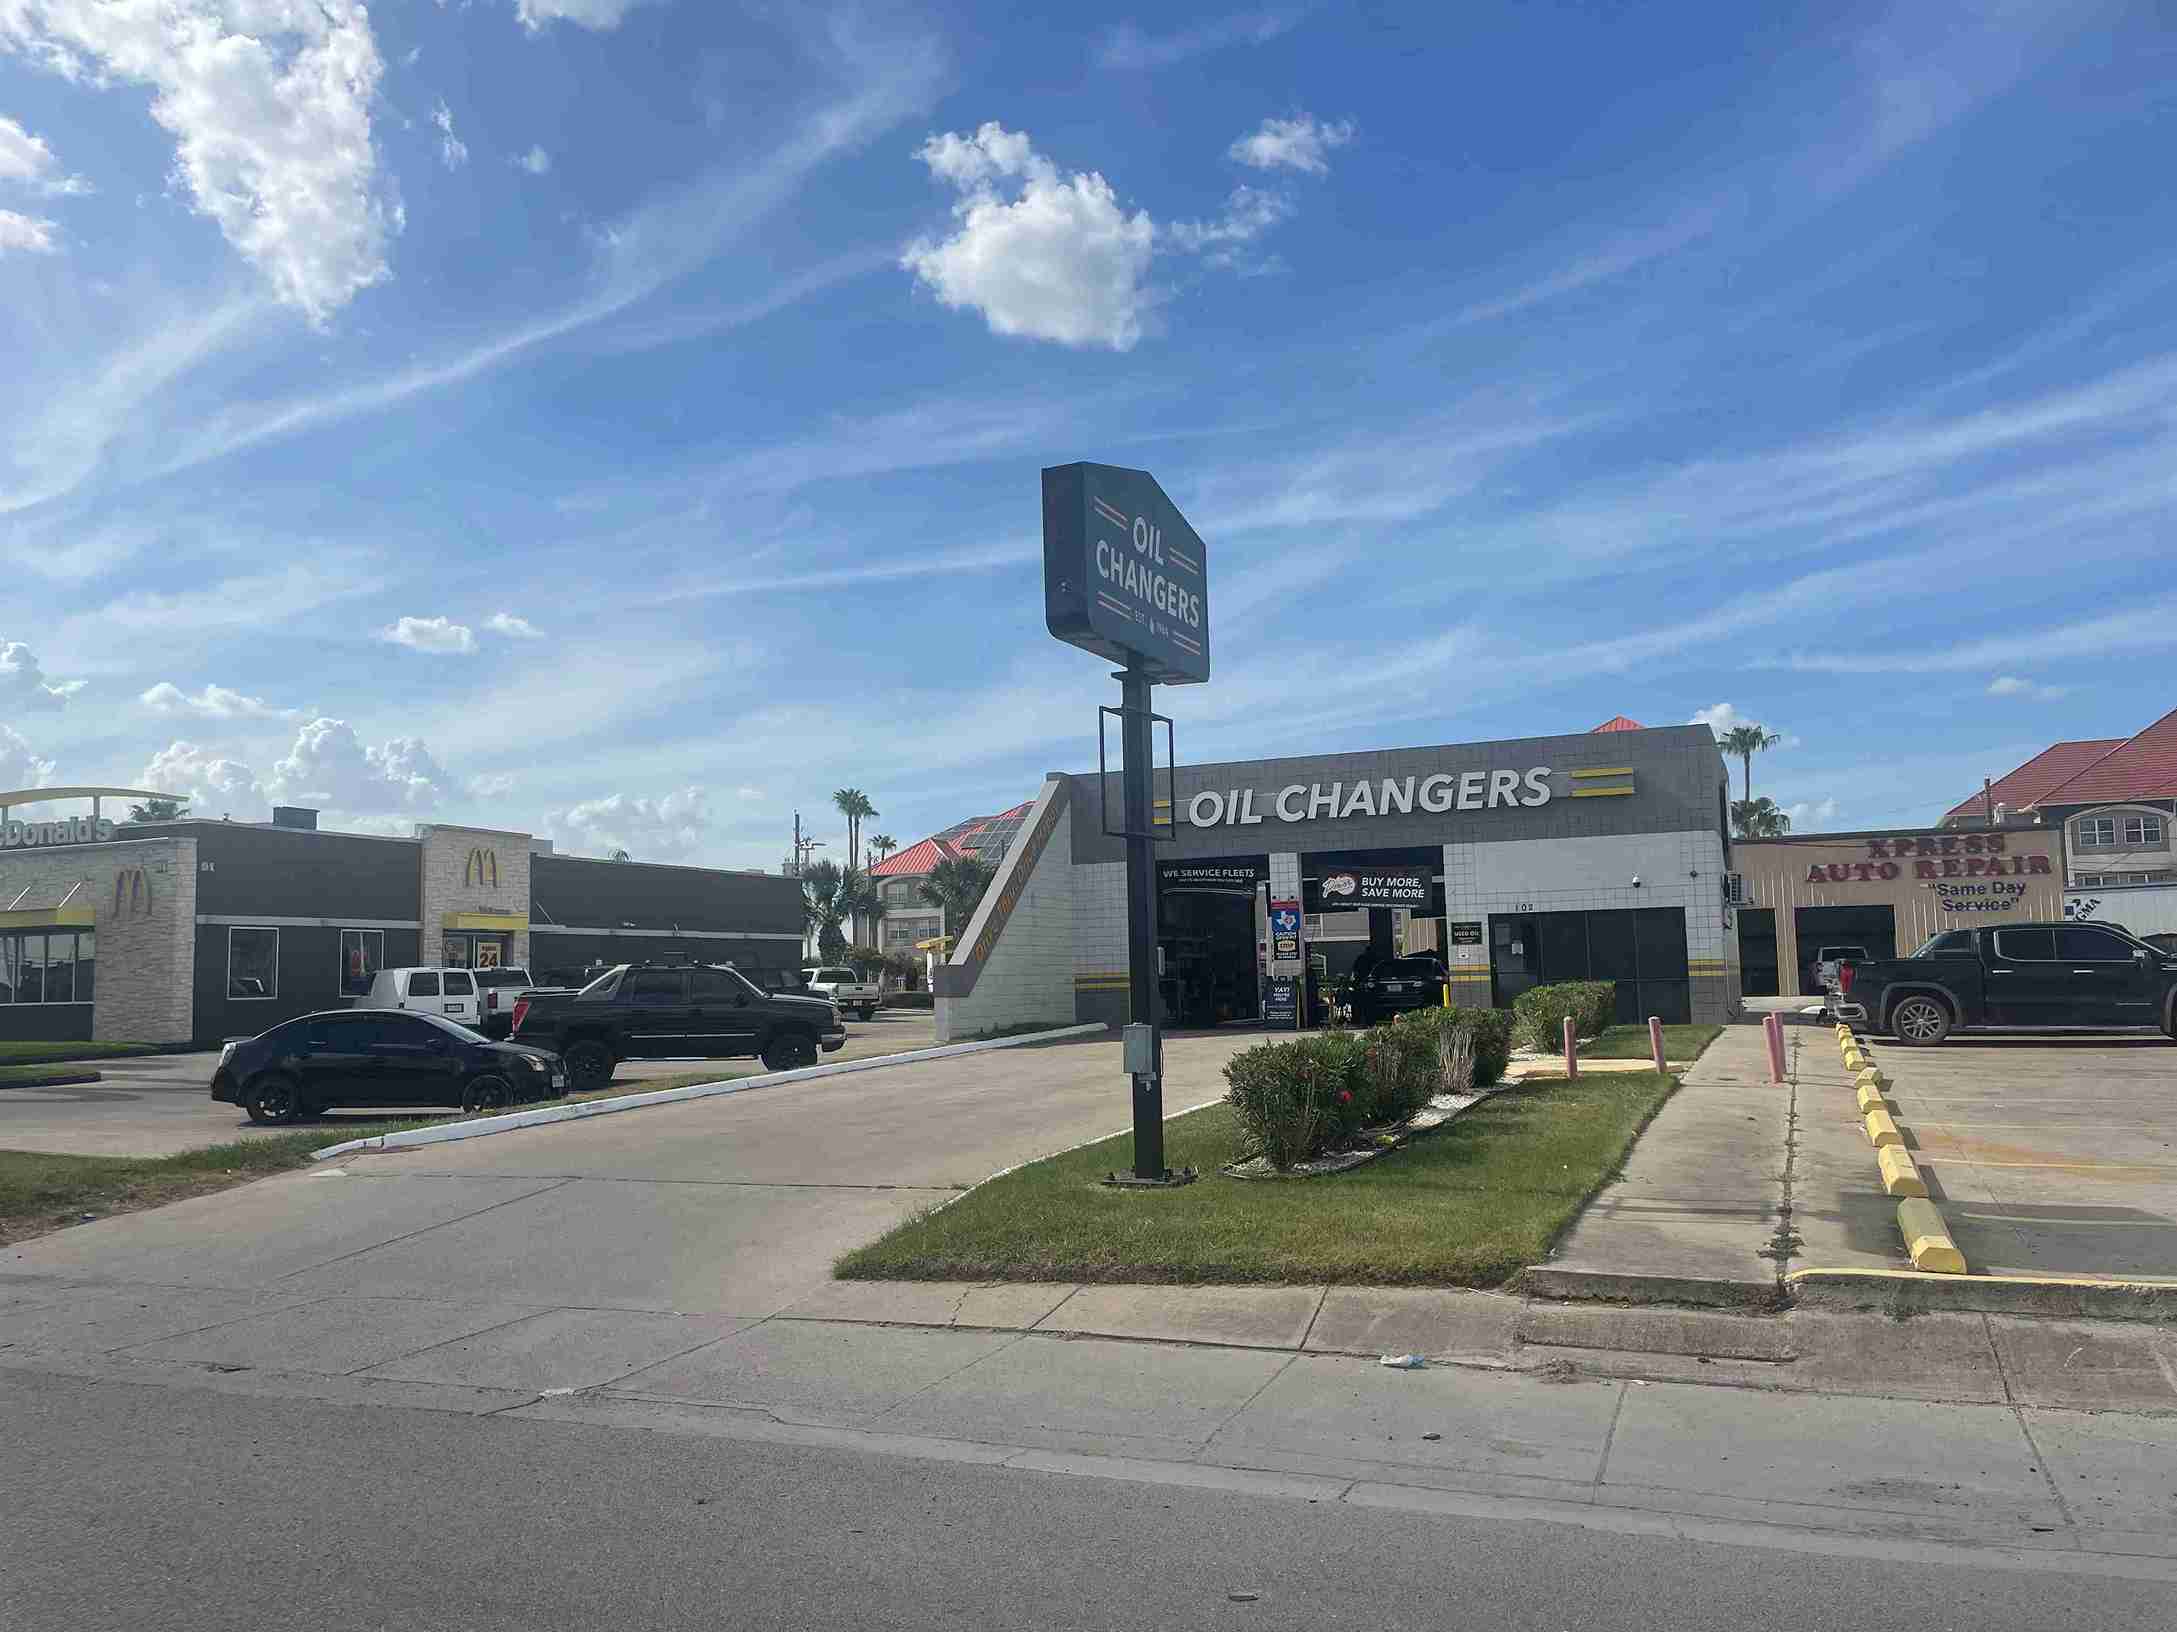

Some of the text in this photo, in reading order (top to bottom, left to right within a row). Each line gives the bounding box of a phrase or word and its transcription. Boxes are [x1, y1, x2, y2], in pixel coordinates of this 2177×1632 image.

[1132, 515, 1164, 566] OIL
[1096, 539, 1200, 628] CHANGERS
[1188, 766, 1553, 828] OIL CHANGERS
[1866, 833, 2005, 859] XPRESS
[1182, 868, 1222, 878] SERVICE
[1222, 868, 1256, 878] FLEETS
[1807, 854, 2053, 883] AUTO REPAIR
[1361, 876, 1422, 889] BUY MORE,
[1992, 881, 2027, 898] Day
[1361, 887, 1390, 897] SAVE
[1392, 888, 1425, 898] MORE
[1514, 903, 1534, 912] 102
[479, 952, 497, 968] 24
